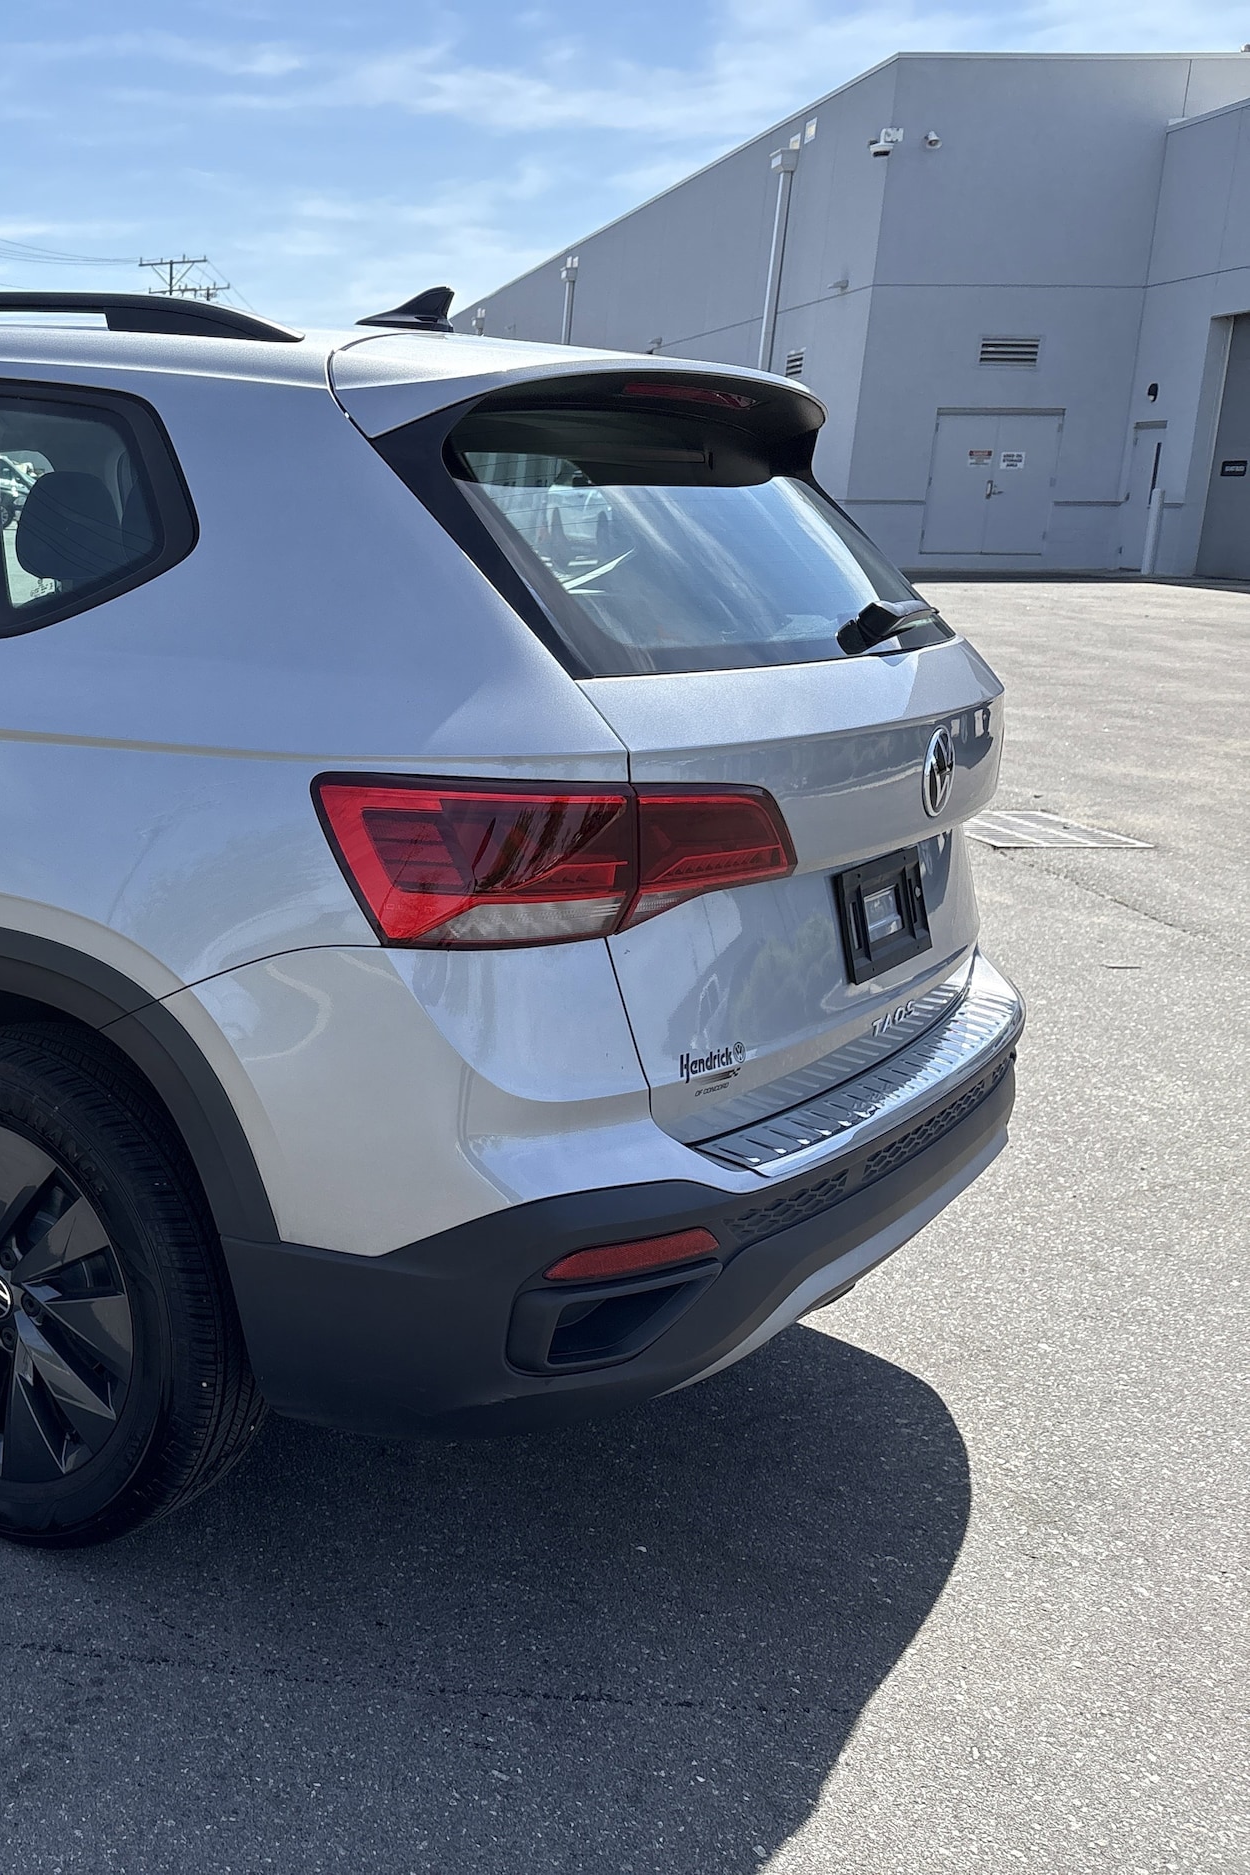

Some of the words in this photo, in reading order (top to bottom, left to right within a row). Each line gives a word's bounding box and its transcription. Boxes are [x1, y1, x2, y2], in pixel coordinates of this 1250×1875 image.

[871, 999, 916, 1038] TAOS
[679, 1047, 733, 1084] Hendrick
[694, 1089, 703, 1097] OF
